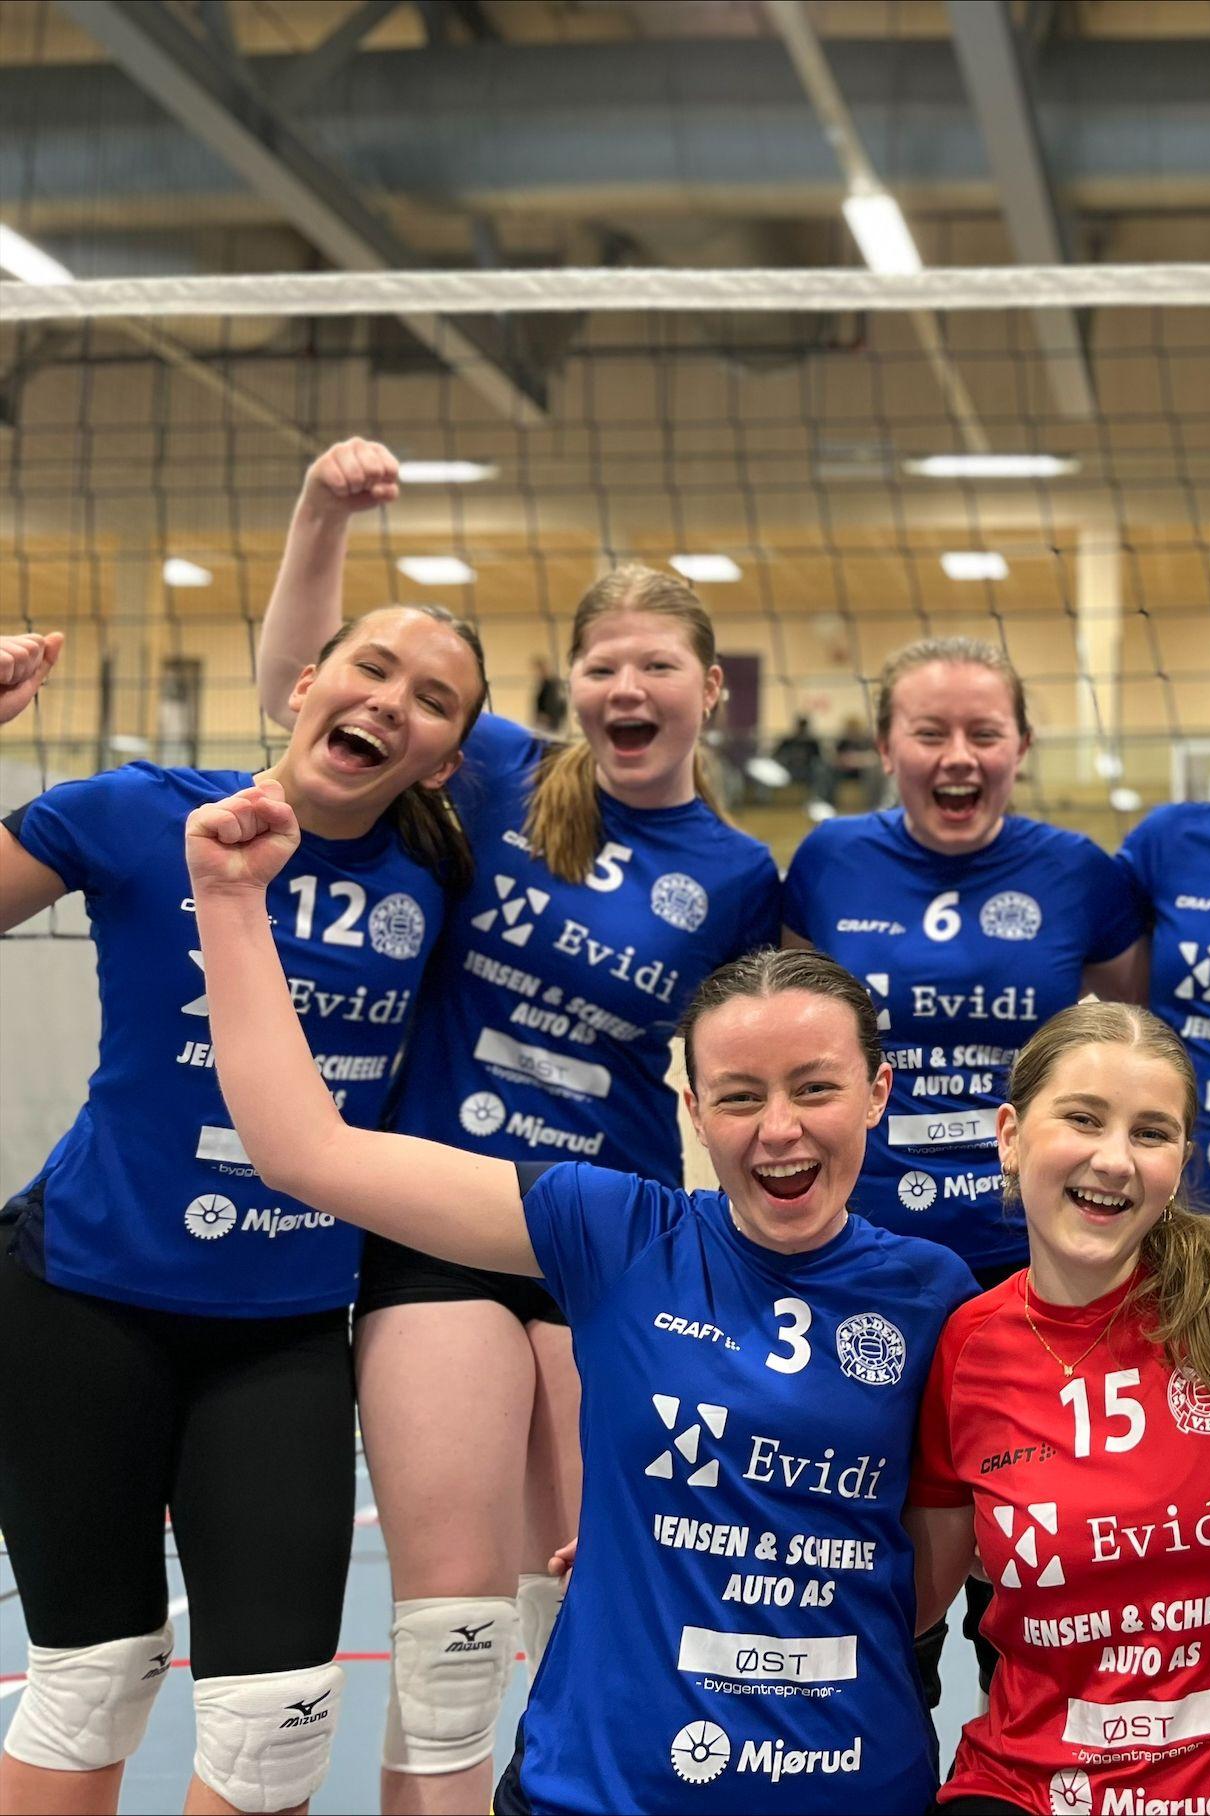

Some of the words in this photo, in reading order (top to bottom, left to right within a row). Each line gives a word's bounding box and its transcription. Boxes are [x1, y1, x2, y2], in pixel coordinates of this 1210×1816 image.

[585, 841, 633, 892] 5
[289, 875, 367, 948] 12
[923, 890, 961, 941] 6
[463, 950, 542, 998] JENSEN
[553, 919, 680, 1003] Evidi
[288, 978, 410, 1024] Evidi
[912, 986, 1037, 1021] Evidi
[510, 1002, 570, 1037] AUTO
[568, 1021, 598, 1045] AS
[930, 1047, 947, 1068] &
[912, 1074, 964, 1097] AUTO
[969, 1073, 993, 1094] AS
[505, 1112, 604, 1156] Mjørud
[928, 1120, 980, 1141] ØST
[944, 1172, 1002, 1201] Mjør
[653, 1312, 724, 1342] CRAFT
[765, 1297, 813, 1374] 3
[1059, 1367, 1147, 1458] 15
[742, 1435, 888, 1500] Evidi
[980, 1447, 1036, 1475] CRAFT
[653, 1514, 750, 1557] JENSEN
[754, 1531, 778, 1562] &
[785, 1533, 876, 1571] SCHEELE
[722, 1573, 795, 1607] AUTO
[800, 1580, 836, 1607] AS
[445, 1641, 491, 1652] MIZUNO
[1023, 1609, 1112, 1648] JENSEN
[1121, 1604, 1145, 1634] &
[735, 1648, 808, 1675] ØST
[1098, 1645, 1162, 1676] AUTO
[1168, 1641, 1201, 1672] AS
[279, 1709, 328, 1729] MIZUNO
[1103, 1716, 1174, 1744] ØST
[736, 1736, 862, 1783] Mjørud
